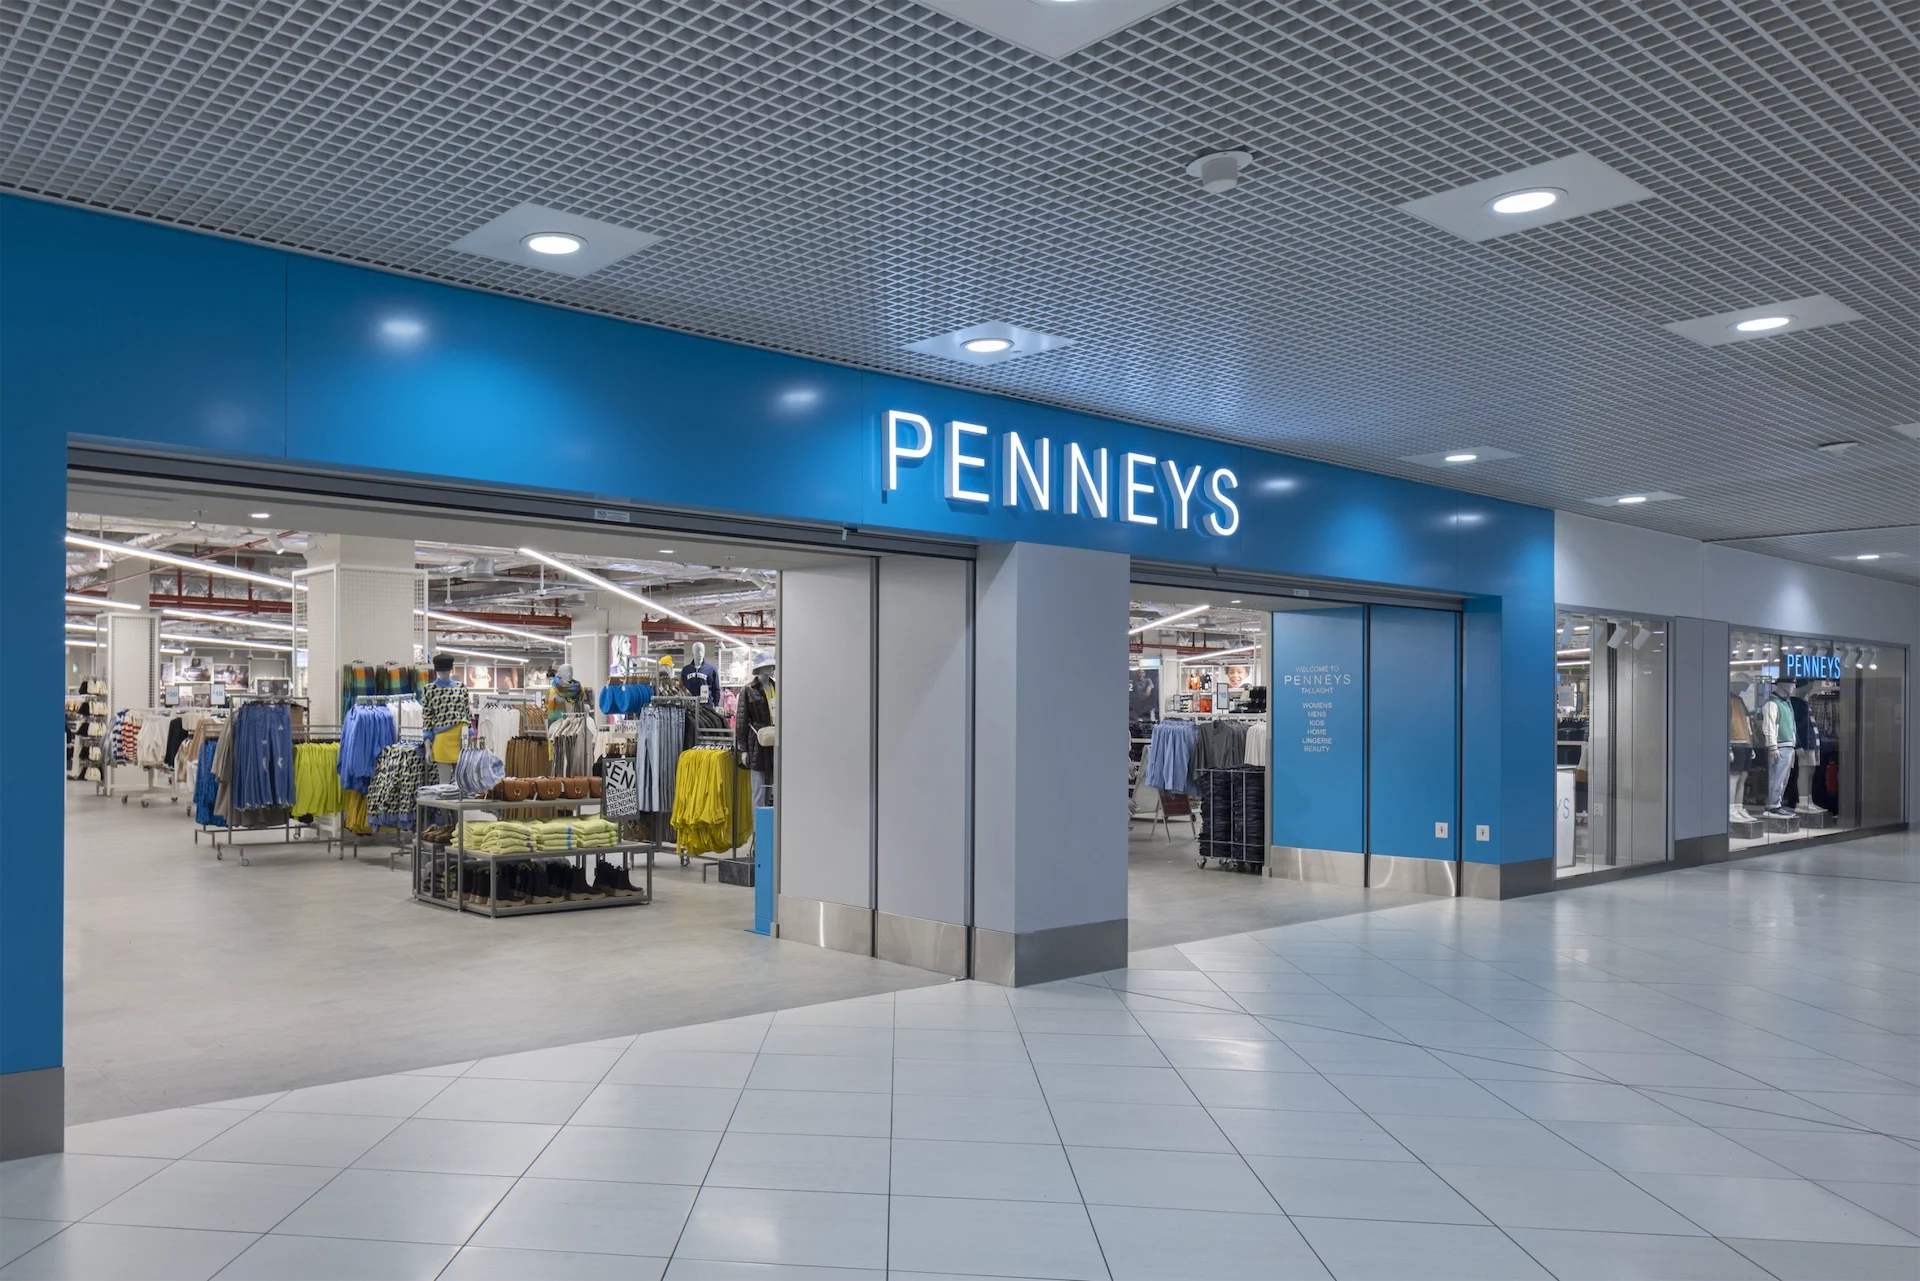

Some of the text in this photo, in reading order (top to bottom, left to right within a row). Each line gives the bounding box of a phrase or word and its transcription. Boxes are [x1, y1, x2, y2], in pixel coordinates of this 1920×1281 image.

[881, 409, 1240, 537] PENNEYS
[1295, 665, 1329, 673] WELCOME
[1786, 653, 1841, 679] PENNEYS
[1284, 674, 1351, 686] PENNEYS
